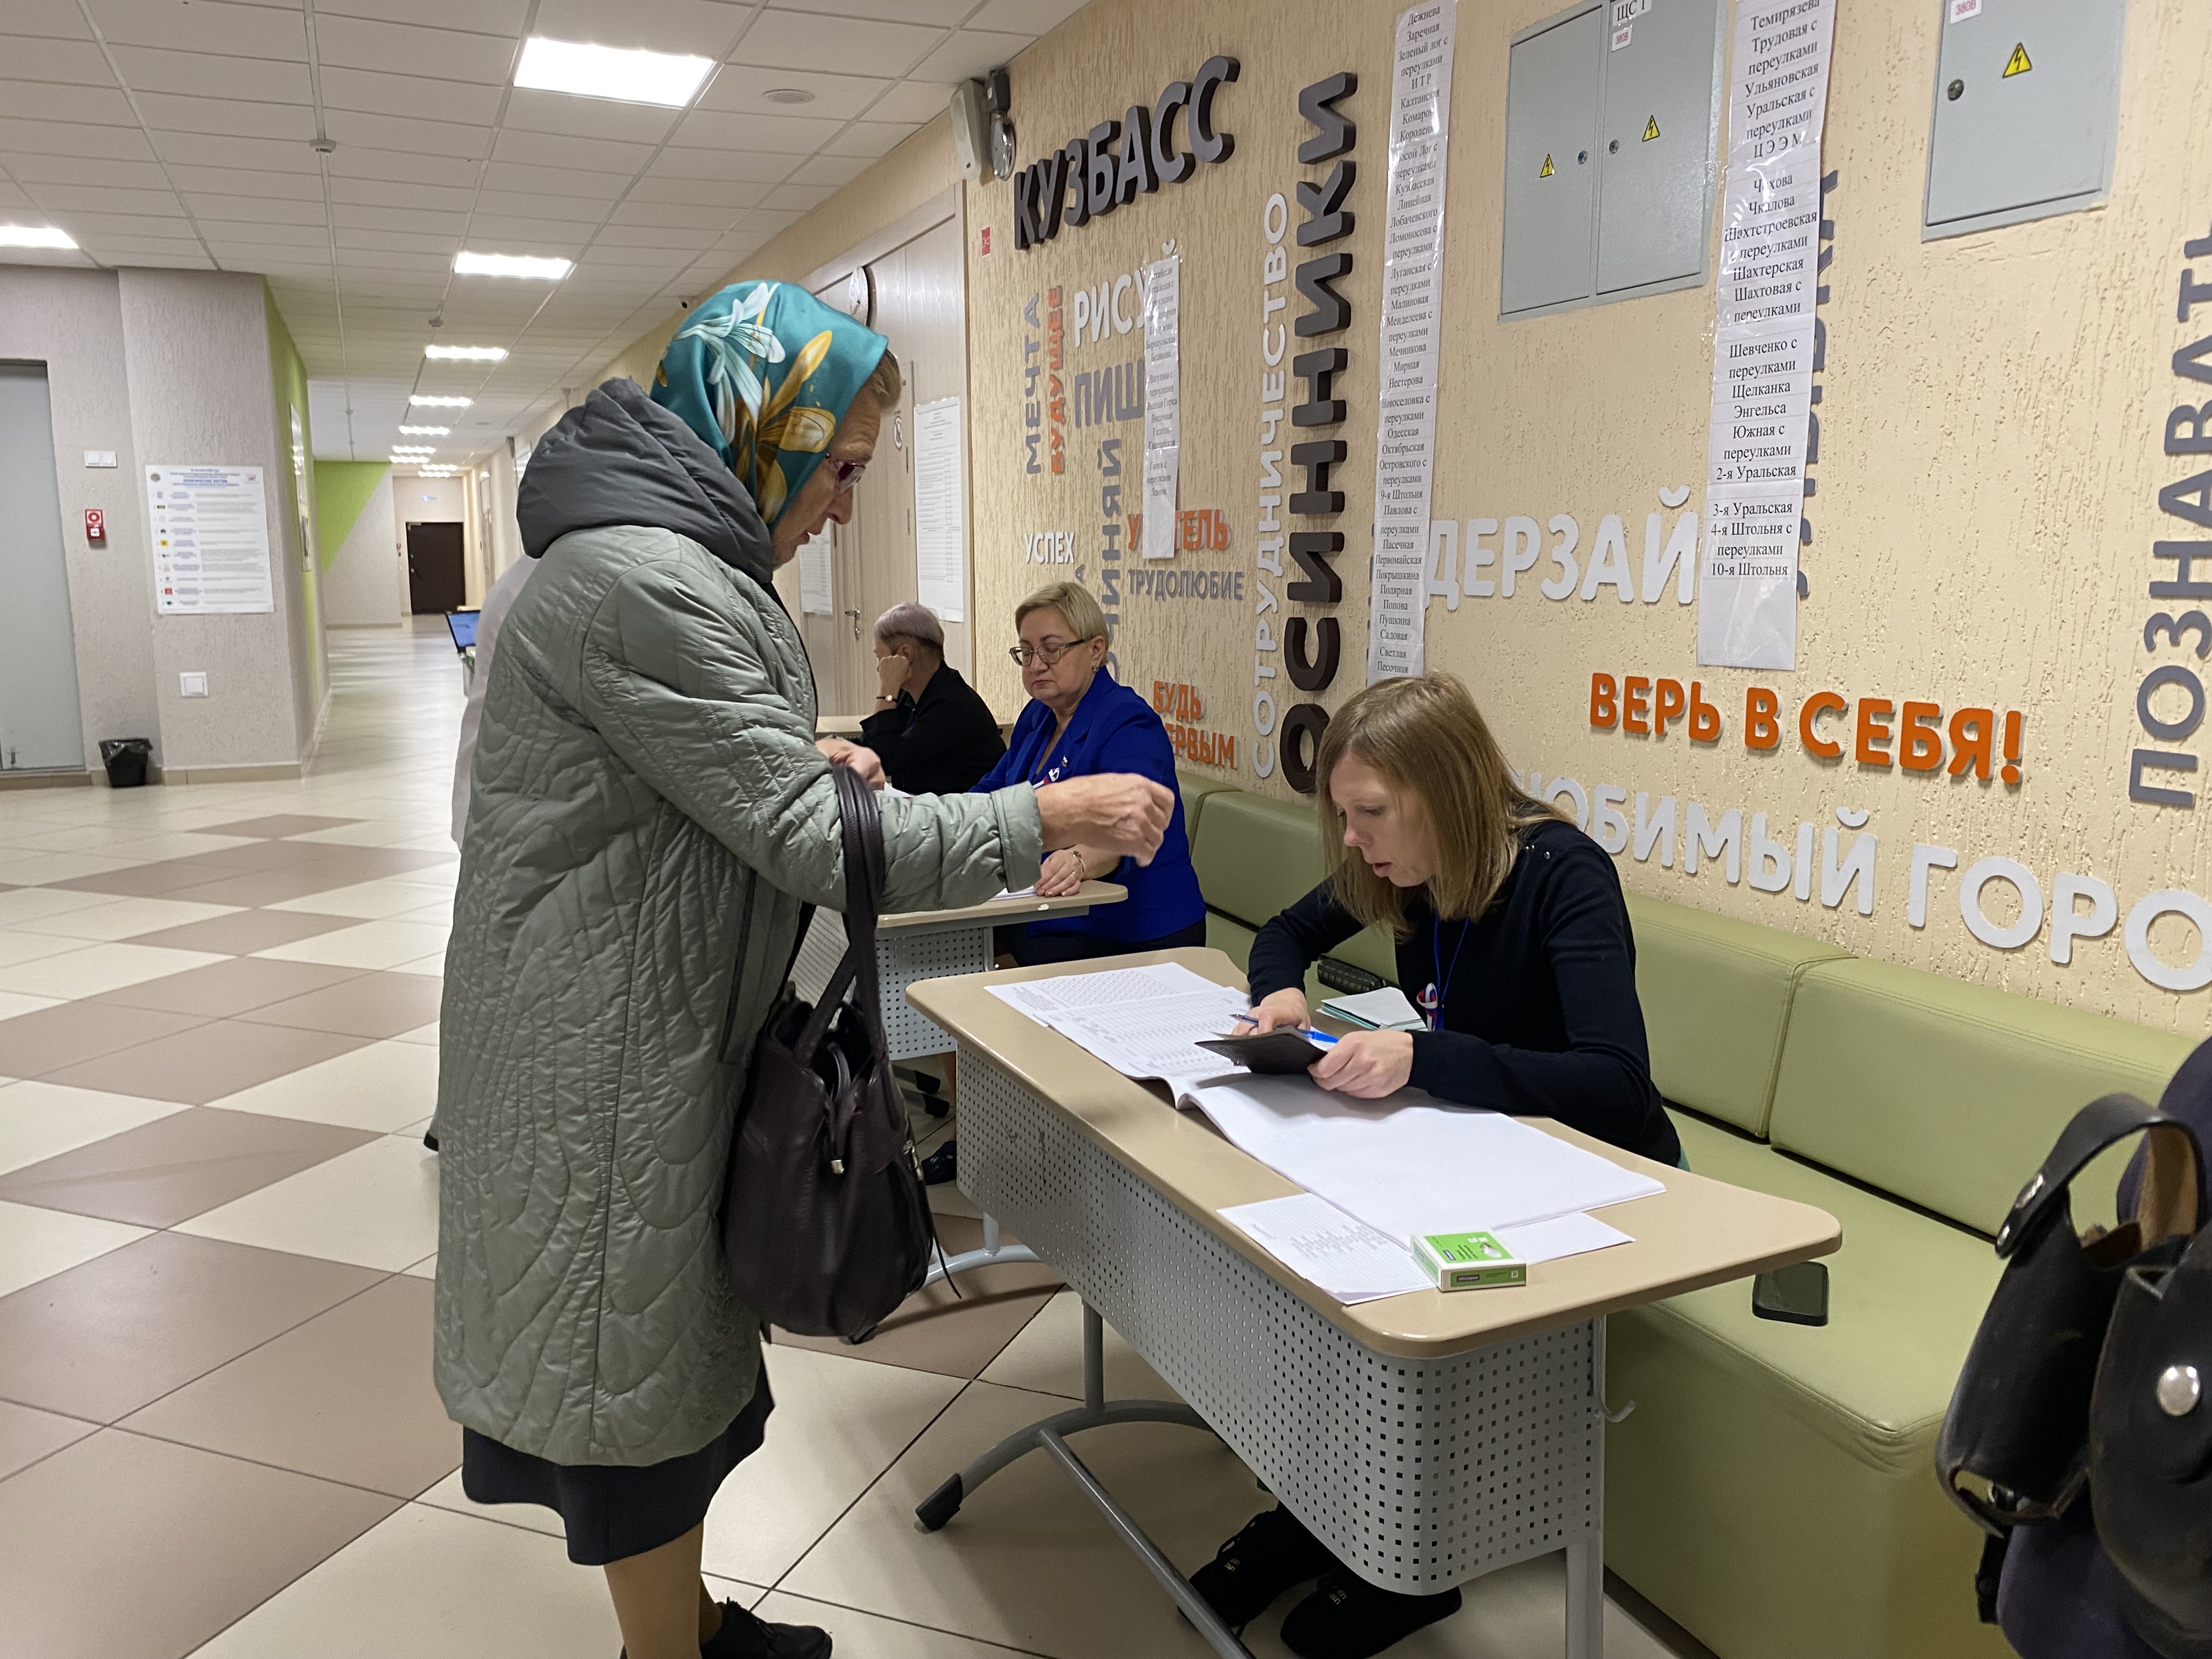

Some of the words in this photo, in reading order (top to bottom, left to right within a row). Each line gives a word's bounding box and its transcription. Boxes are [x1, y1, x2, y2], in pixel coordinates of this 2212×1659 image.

[1407, 6, 1440, 26] Дежнева
[1751, 0, 1820, 31] Темирязева
[1407, 23, 1440, 43] Заречная
[1752, 25, 1808, 54] Трудовая
[1811, 20, 1818, 31] с
[1398, 42, 1428, 61] Зеленый
[1443, 37, 1448, 45] с
[1401, 54, 1443, 77] переулками
[1748, 42, 1818, 75] переулками
[1745, 63, 1819, 98] Ульяновская
[1401, 89, 1440, 109] Калтанская
[1747, 89, 1807, 120] Уральская
[1809, 86, 1815, 98] с
[1403, 109, 1434, 125] Комаров
[1747, 109, 1812, 140] переулками
[1400, 125, 1434, 142] Короленк
[1014, 55, 1240, 250] КУЗБАСС
[1398, 148, 1417, 162] осой
[1395, 160, 1436, 180] переулками
[1396, 177, 1435, 197] Кузбасская
[1397, 194, 1431, 211] Линейная
[1390, 208, 1437, 228] Лобачевского
[1724, 211, 1818, 242] Шахтстроевская
[1390, 228, 1431, 244] Ломоносова
[1392, 242, 1432, 259] переулками
[1740, 236, 1808, 261] переулками
[1390, 264, 1426, 281] Луганская
[1427, 262, 1432, 270] с
[1733, 258, 1804, 281] Шахтерская
[1390, 279, 1431, 297] переулками
[1735, 282, 1792, 302] Шахтовая
[1795, 281, 1802, 291] с
[1391, 296, 1429, 311] Малиновая
[1386, 313, 1426, 328] Менделеева
[1428, 311, 1432, 319] с
[1734, 302, 1801, 324] переулками
[1389, 328, 1429, 344] переулками
[1389, 344, 1426, 358] Мечникова
[1729, 341, 1788, 358] Шевченко
[1791, 338, 1797, 349] с
[1393, 360, 1420, 373] Мирная
[1729, 360, 1796, 380] переулками
[1024, 292, 1041, 475] МЕЧТА
[1047, 285, 1063, 473] БУДУЩЕЕ
[1389, 376, 1423, 389] Нестерова
[1074, 358, 1144, 429] ПИШ
[1732, 381, 1791, 399] Щелканка
[1381, 396, 1424, 409] Новоселовка
[1426, 395, 1431, 403] с
[1384, 411, 1424, 426] переулками
[1734, 404, 1786, 419] Энгельса
[1279, 72, 1357, 793] ОСИННИКИ
[1387, 428, 1419, 439] Одесская
[1733, 425, 1775, 439] Южная
[1778, 425, 1785, 435] с
[1382, 443, 1425, 456] Октябрьская
[1723, 445, 1791, 462] переулками
[1379, 459, 1421, 472] Островского
[1422, 459, 1427, 467] с
[1717, 467, 1733, 480] 2-я
[1736, 465, 1796, 482] Уральская
[1252, 193, 1288, 778] СОТРУДНИЧЕСТВО
[1383, 475, 1421, 487] переулками
[1380, 490, 1391, 500] 9-я
[1392, 489, 1423, 500] Штольня
[1384, 505, 1412, 515] Павлова
[1713, 504, 1729, 516] 3-я
[1733, 502, 1793, 519] Уральская
[1127, 509, 1229, 551] УТЕЛЬ
[1380, 526, 1419, 537] переулками
[1711, 523, 1728, 536] 4-я
[1731, 522, 1783, 535] Штольня
[1786, 524, 1792, 534] с
[1025, 532, 1075, 563] УСПЕХ
[1383, 539, 1414, 550] Пасечная
[1425, 485, 1699, 611] ДЕРЗАЙ
[1717, 544, 1784, 559] переулками
[1098, 438, 1120, 685] ЧИНЯЙ
[1375, 554, 1422, 567] Первомайская
[1712, 563, 1735, 576] 10-я
[1738, 563, 1788, 576] Штольня
[1376, 569, 1419, 582] Покрышкина
[1128, 569, 1244, 601] ТРУДОЛЮБИЕ
[1380, 584, 1412, 597] Полярная
[1383, 599, 1408, 610] Попова
[1379, 614, 1410, 627] Пушкина
[1380, 629, 1408, 641] Садовая
[1379, 646, 1407, 658] Светлая
[1377, 661, 1408, 674] Песочная
[1153, 680, 1203, 724] БУДЬ
[1590, 673, 1724, 741] ВЕРЬ
[1745, 687, 1781, 749] В
[1799, 691, 2025, 785] СЕБЯ!
[1165, 723, 1235, 770] ЕРВЫМ
[1510, 769, 1876, 915] ЮБИМЫЙ
[1908, 844, 2212, 990] ГОРО
